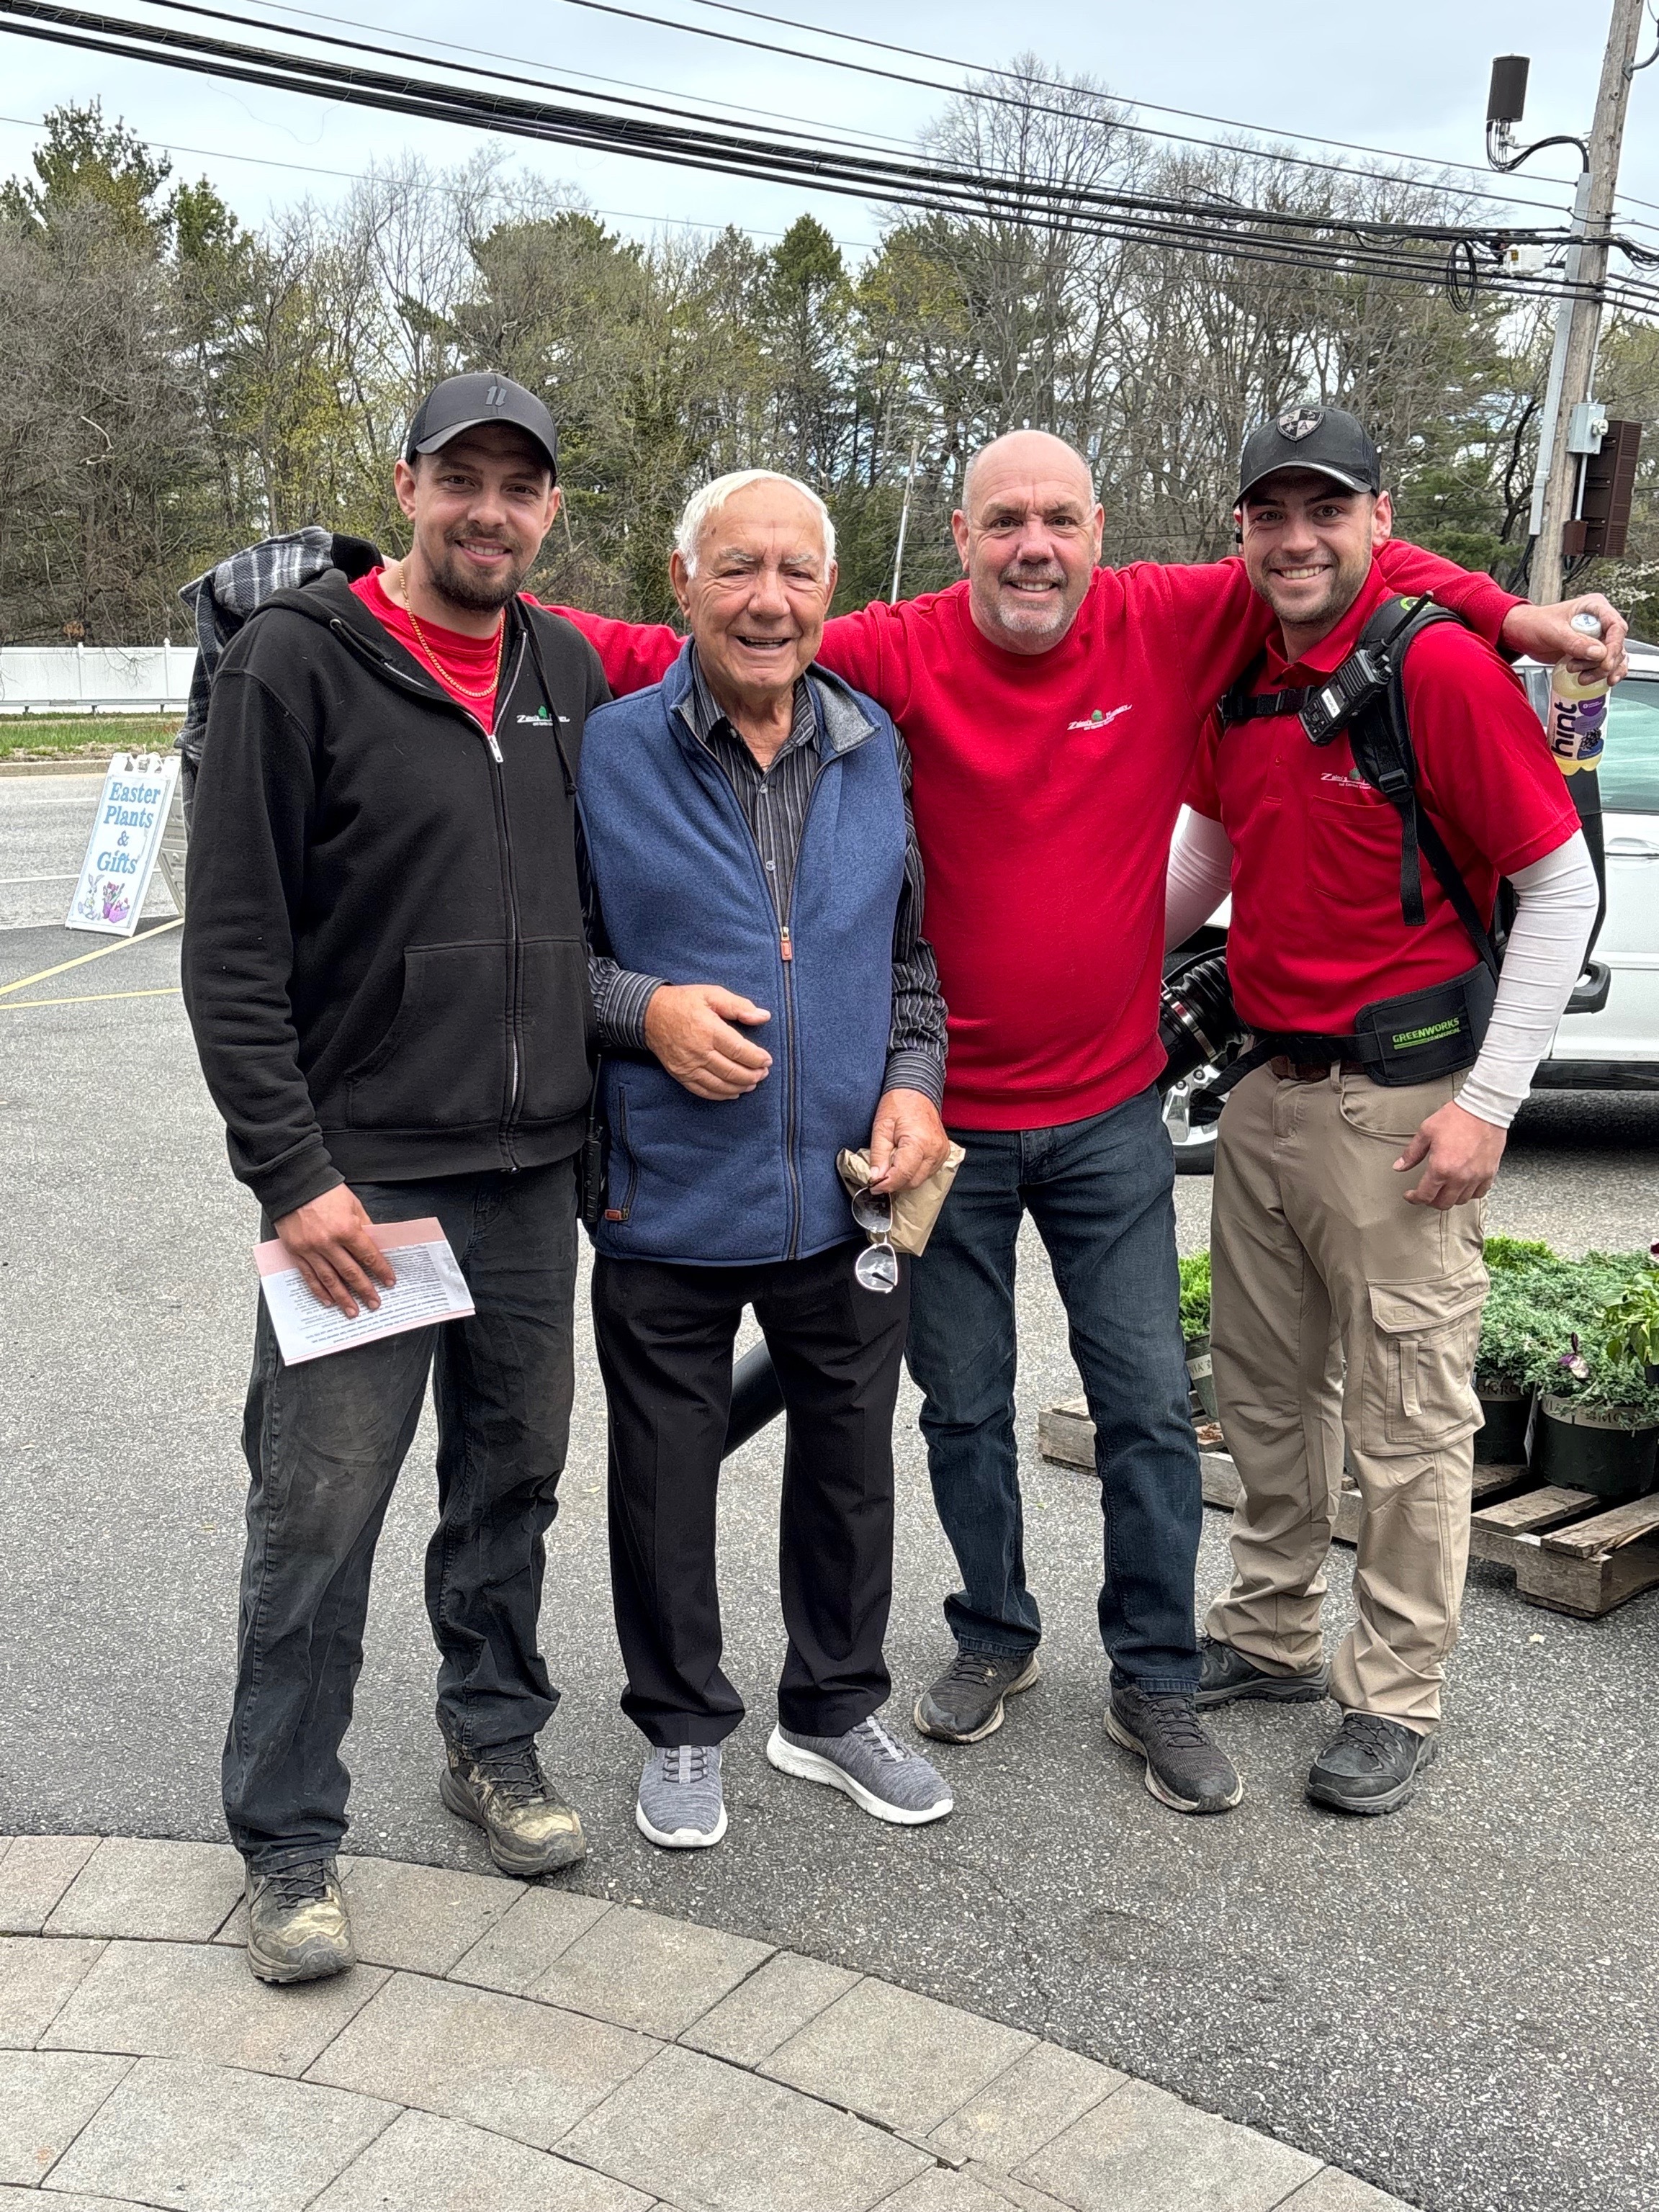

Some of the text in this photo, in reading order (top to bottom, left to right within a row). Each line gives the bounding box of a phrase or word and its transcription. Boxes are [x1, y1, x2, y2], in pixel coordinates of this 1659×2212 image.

[1298, 421, 1309, 430] A
[1551, 701, 1577, 757] hint
[109, 781, 161, 804] Easter
[104, 805, 154, 828] Plants
[117, 830, 130, 847] &
[96, 850, 138, 875] Gifts
[1392, 1017, 1460, 1043] GREENWORKS
[1426, 1027, 1462, 1042] COMMERCIAL
